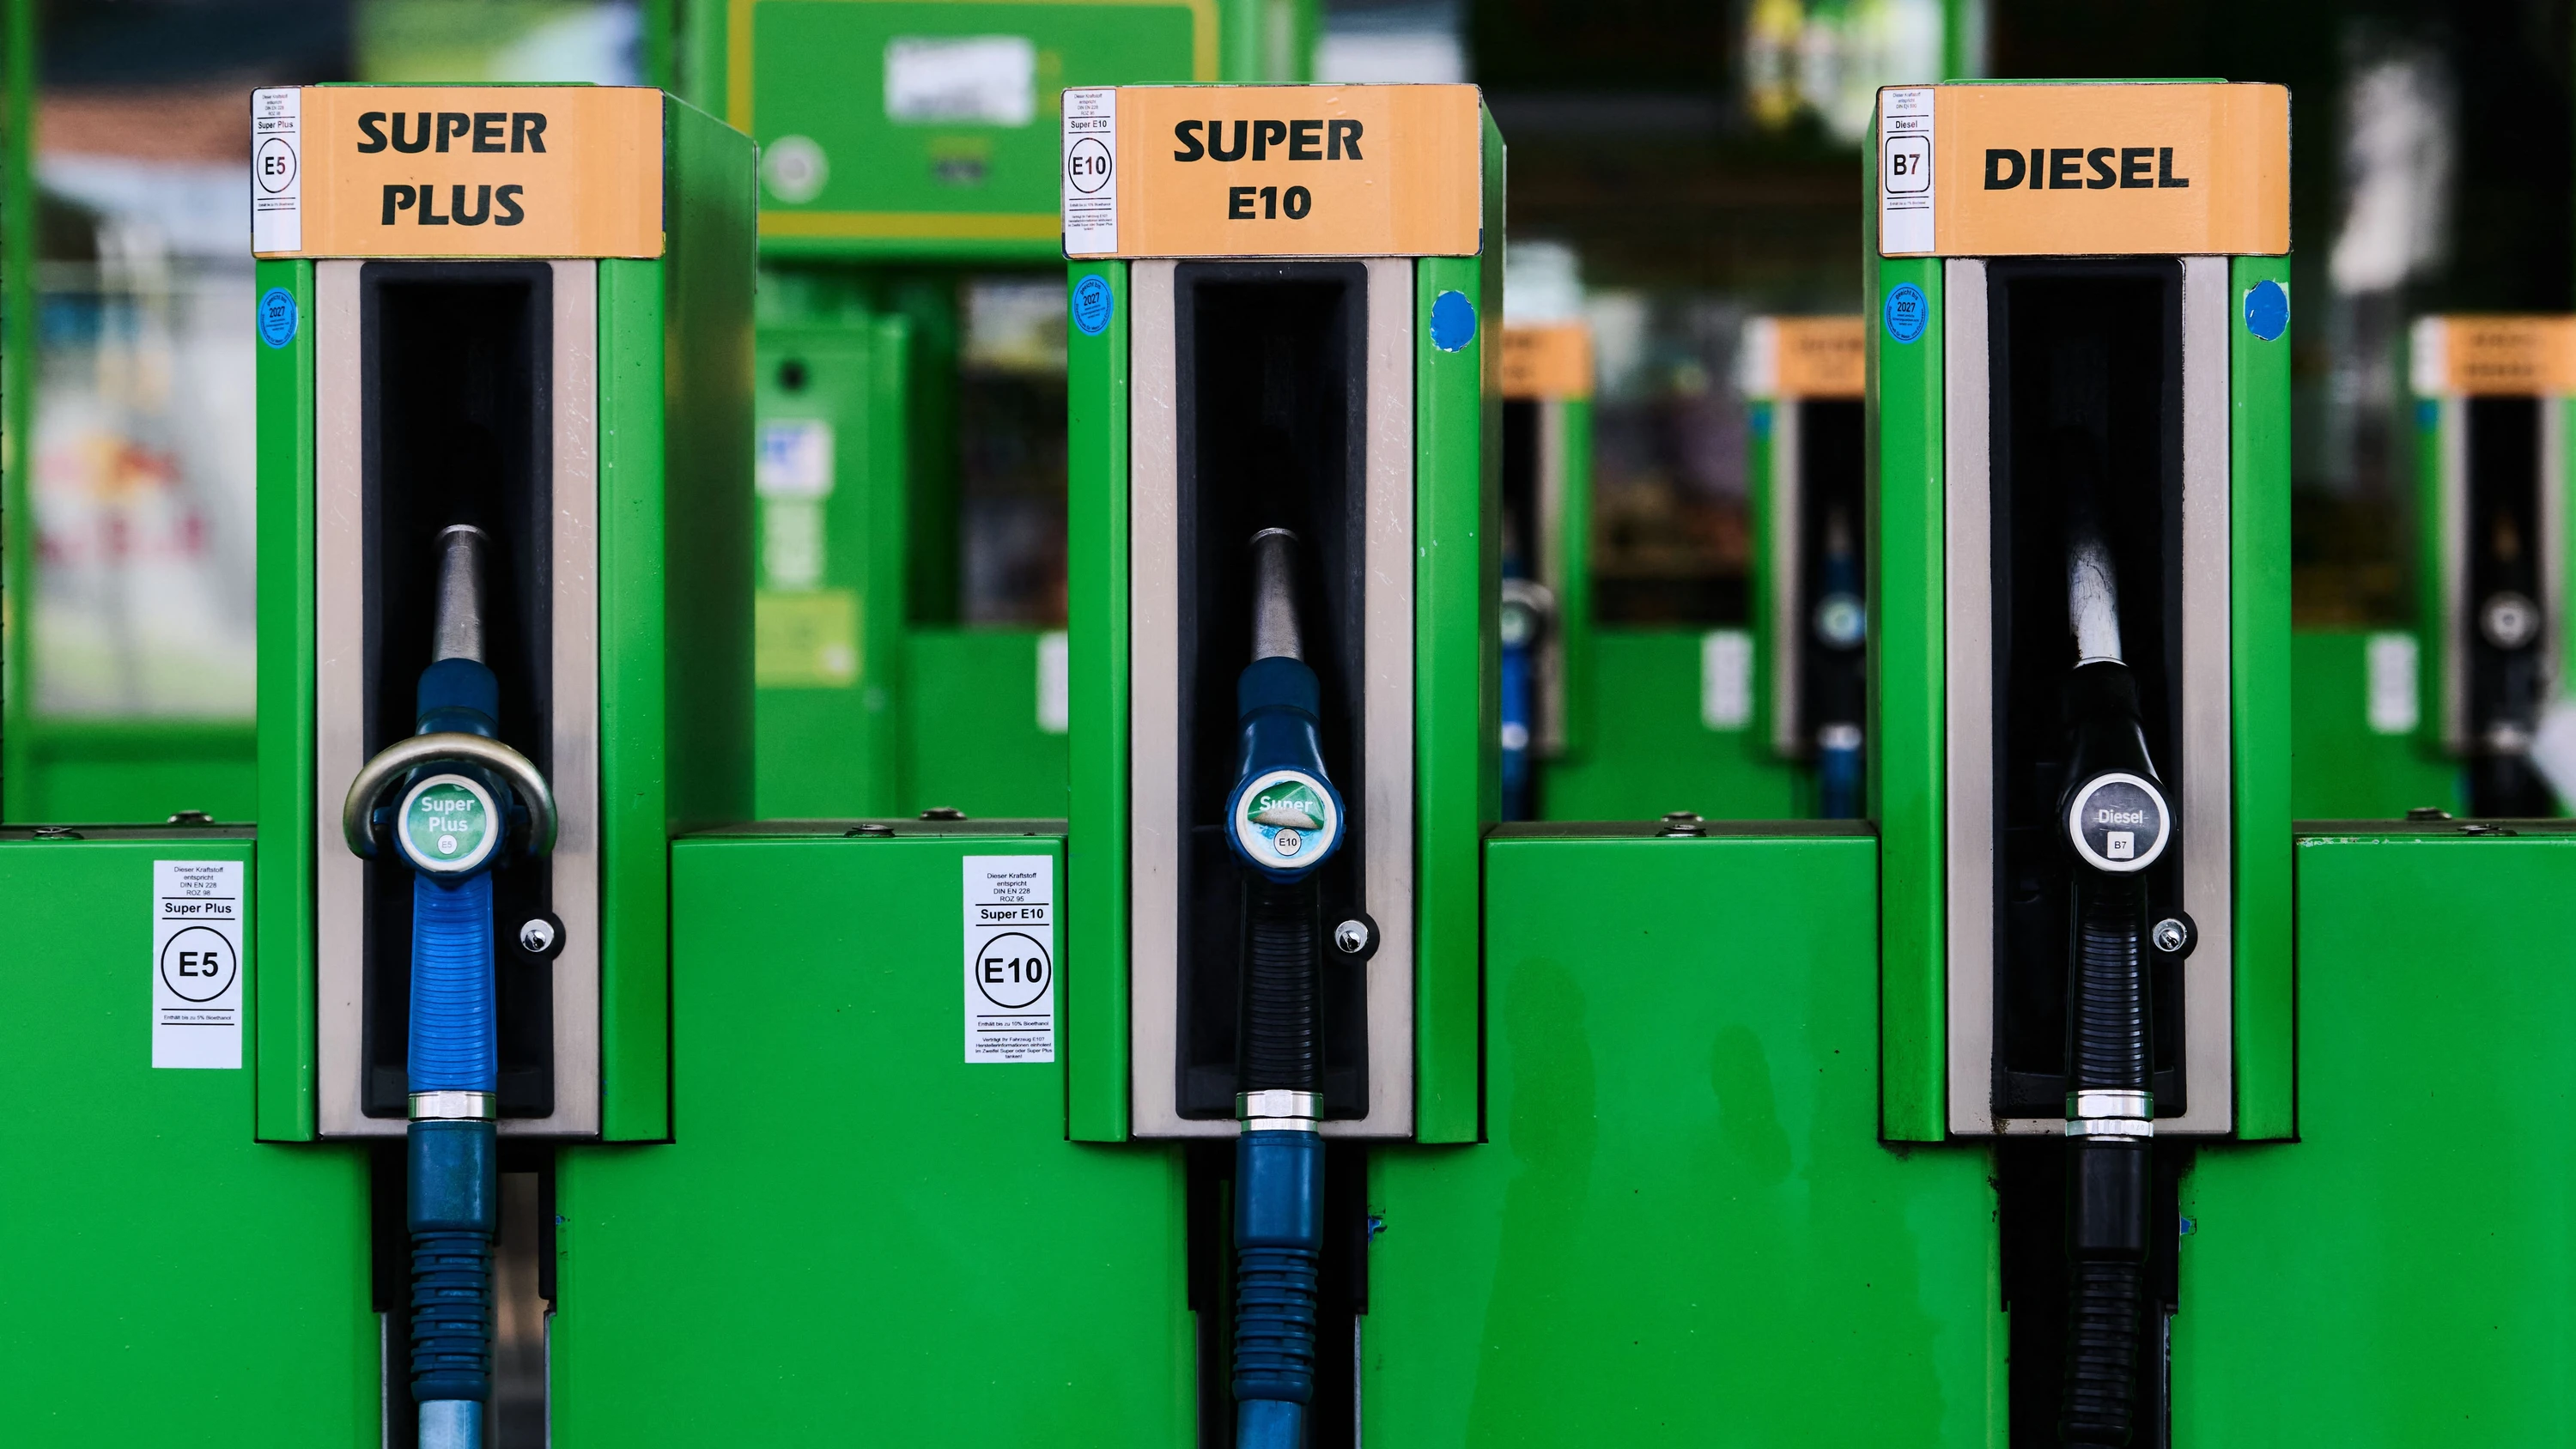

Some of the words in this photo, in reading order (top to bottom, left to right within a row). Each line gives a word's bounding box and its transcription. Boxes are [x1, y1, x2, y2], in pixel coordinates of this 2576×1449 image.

[258, 121, 276, 130] Super
[357, 112, 548, 154] SUPER
[1071, 120, 1091, 130] Super
[1896, 120, 1917, 129] Diesel
[1174, 119, 1364, 162] SUPER
[265, 156, 286, 175] E5
[1072, 156, 1106, 175] E10
[1894, 154, 1921, 175] B7
[1984, 147, 2190, 191] DIESEL
[381, 184, 525, 226] PLUS
[1228, 185, 1312, 220] E10
[1084, 292, 1100, 306] 2027
[1897, 301, 1916, 312] 2027
[269, 306, 285, 318] 2027
[421, 797, 475, 815] Super
[428, 817, 468, 832] Plus
[2099, 809, 2143, 823] Diesel
[165, 903, 201, 915] Super
[205, 903, 232, 913] Plus
[981, 909, 1018, 921] Super
[1021, 909, 1043, 919] E10
[179, 952, 218, 977] E5
[985, 958, 1042, 983] E10
